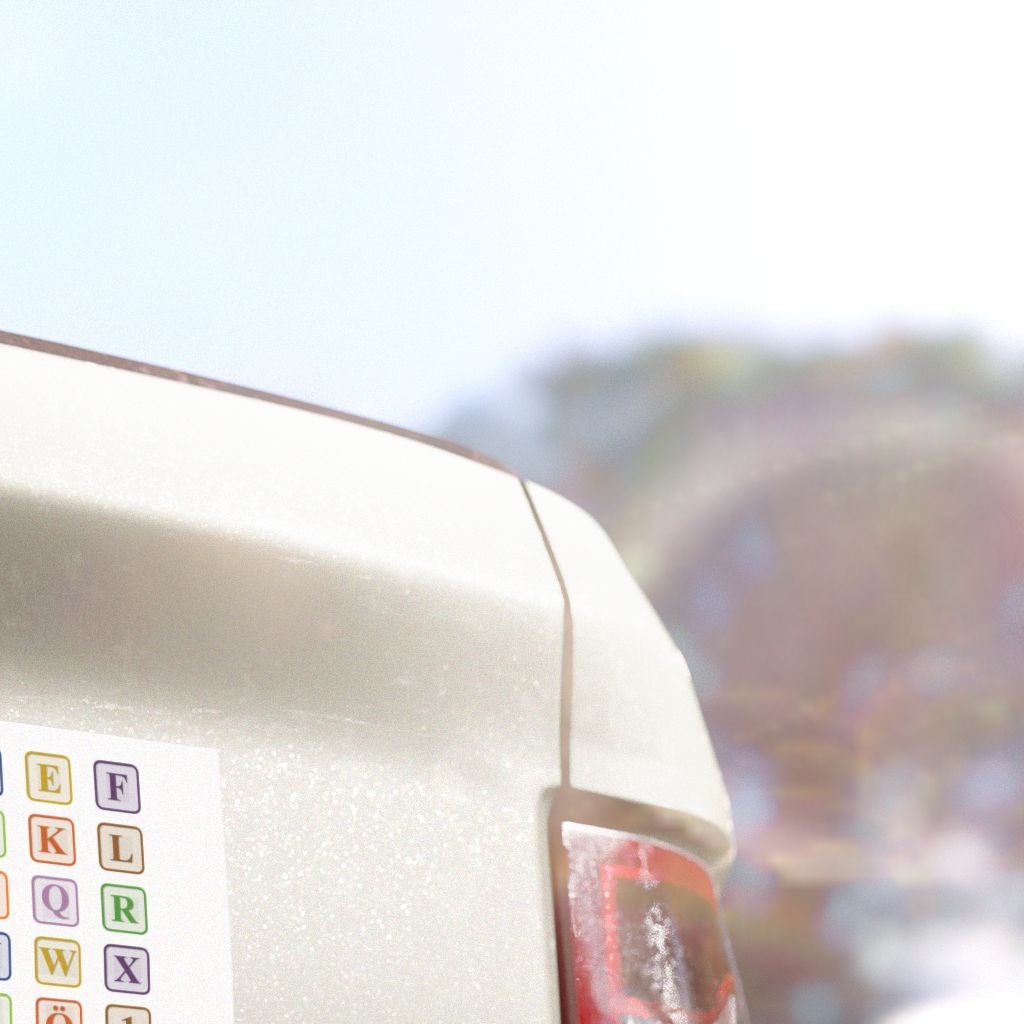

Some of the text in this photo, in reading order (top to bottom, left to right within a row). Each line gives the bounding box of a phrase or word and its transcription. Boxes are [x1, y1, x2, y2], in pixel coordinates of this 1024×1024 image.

[39, 763, 61, 793] E
[108, 772, 127, 801] F
[39, 825, 66, 855] K
[111, 834, 133, 863] L
[41, 884, 69, 920] Q
[112, 895, 137, 924] R
[41, 947, 75, 976] W
[115, 955, 140, 984] X
